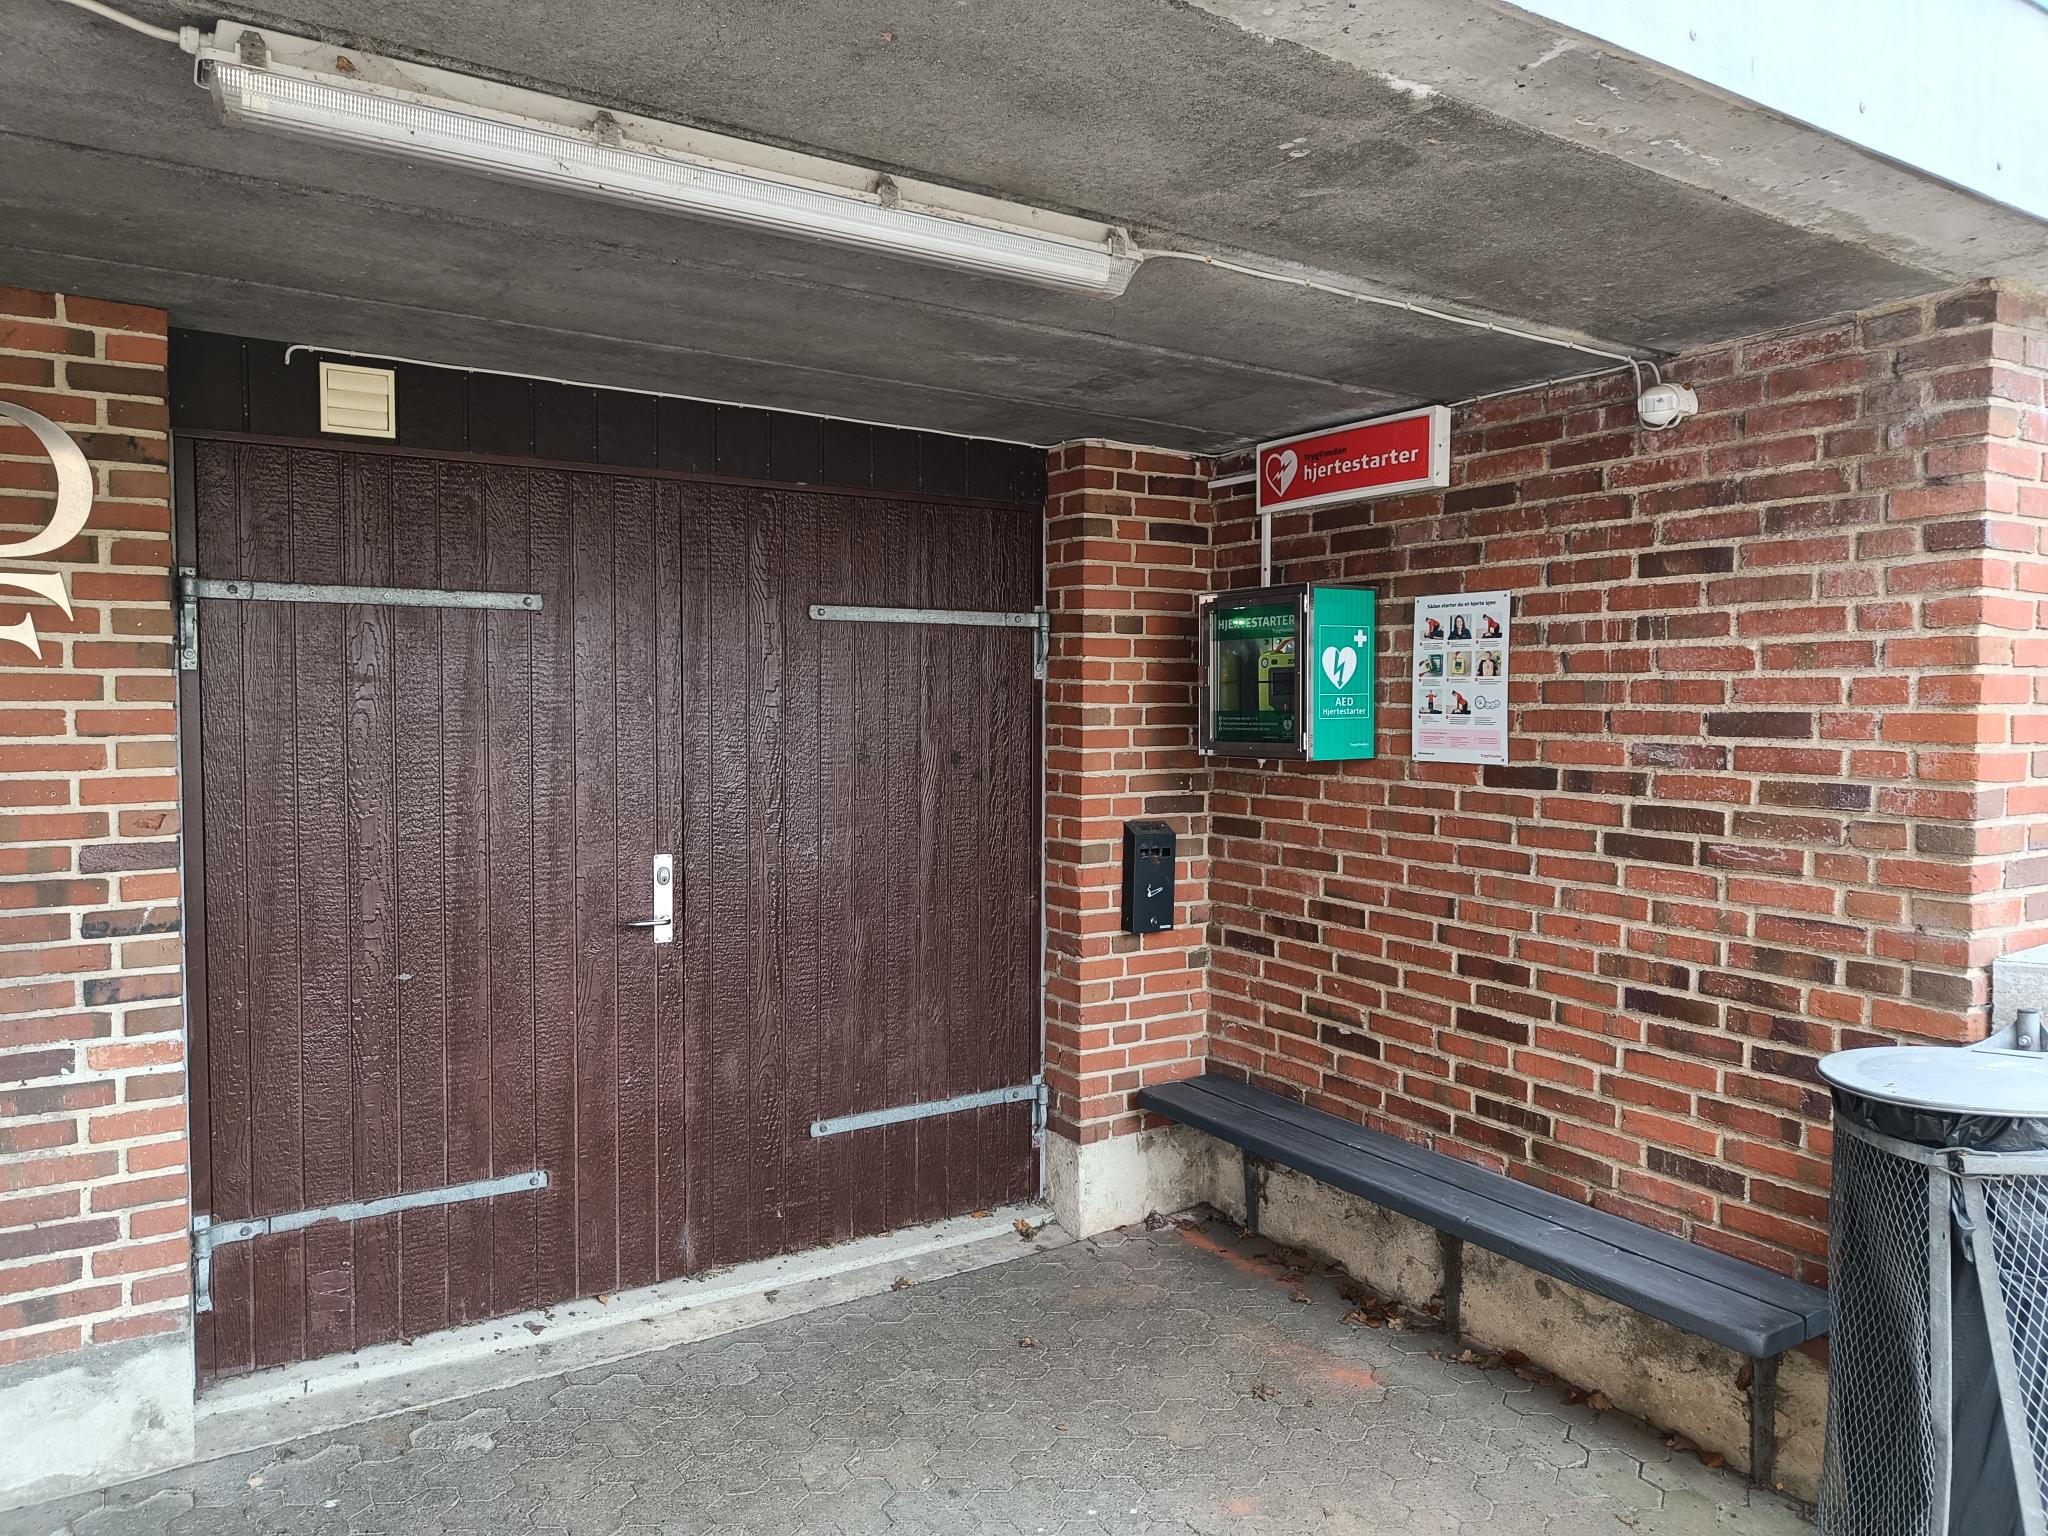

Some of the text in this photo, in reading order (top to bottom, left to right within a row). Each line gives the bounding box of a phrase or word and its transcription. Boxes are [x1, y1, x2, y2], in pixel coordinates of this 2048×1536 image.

[1304, 447, 1347, 461] TrygFonden
[1304, 448, 1418, 483] hjertestarter
[1335, 697, 1354, 707] AED
[1322, 708, 1366, 716] Hjertestarter
